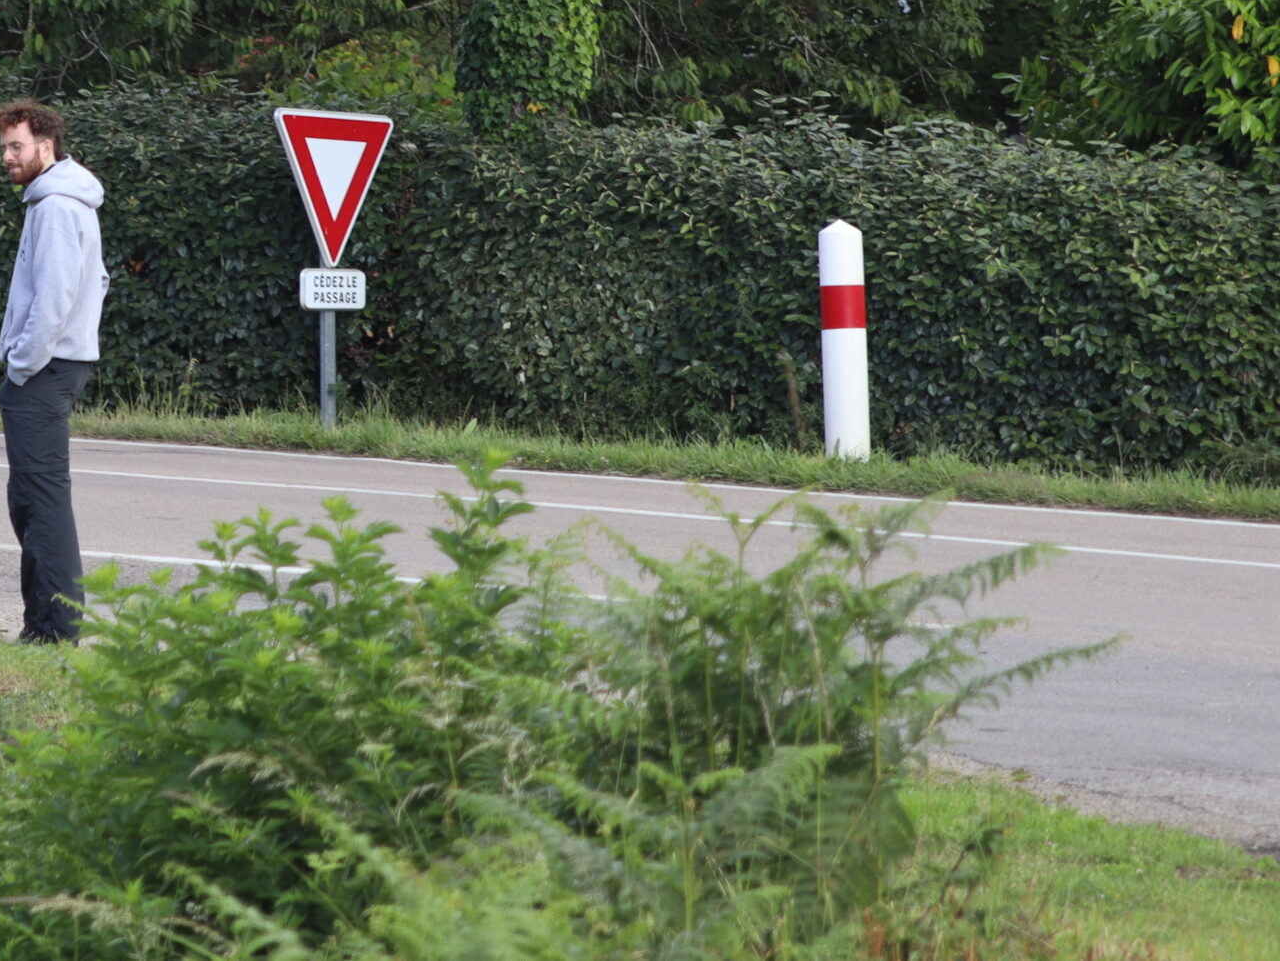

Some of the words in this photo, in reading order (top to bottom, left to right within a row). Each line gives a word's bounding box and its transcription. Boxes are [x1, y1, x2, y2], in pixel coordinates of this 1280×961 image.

[313, 274, 344, 288] CÉDEZ
[346, 276, 357, 288] LE
[313, 292, 357, 304] PASSAGE
